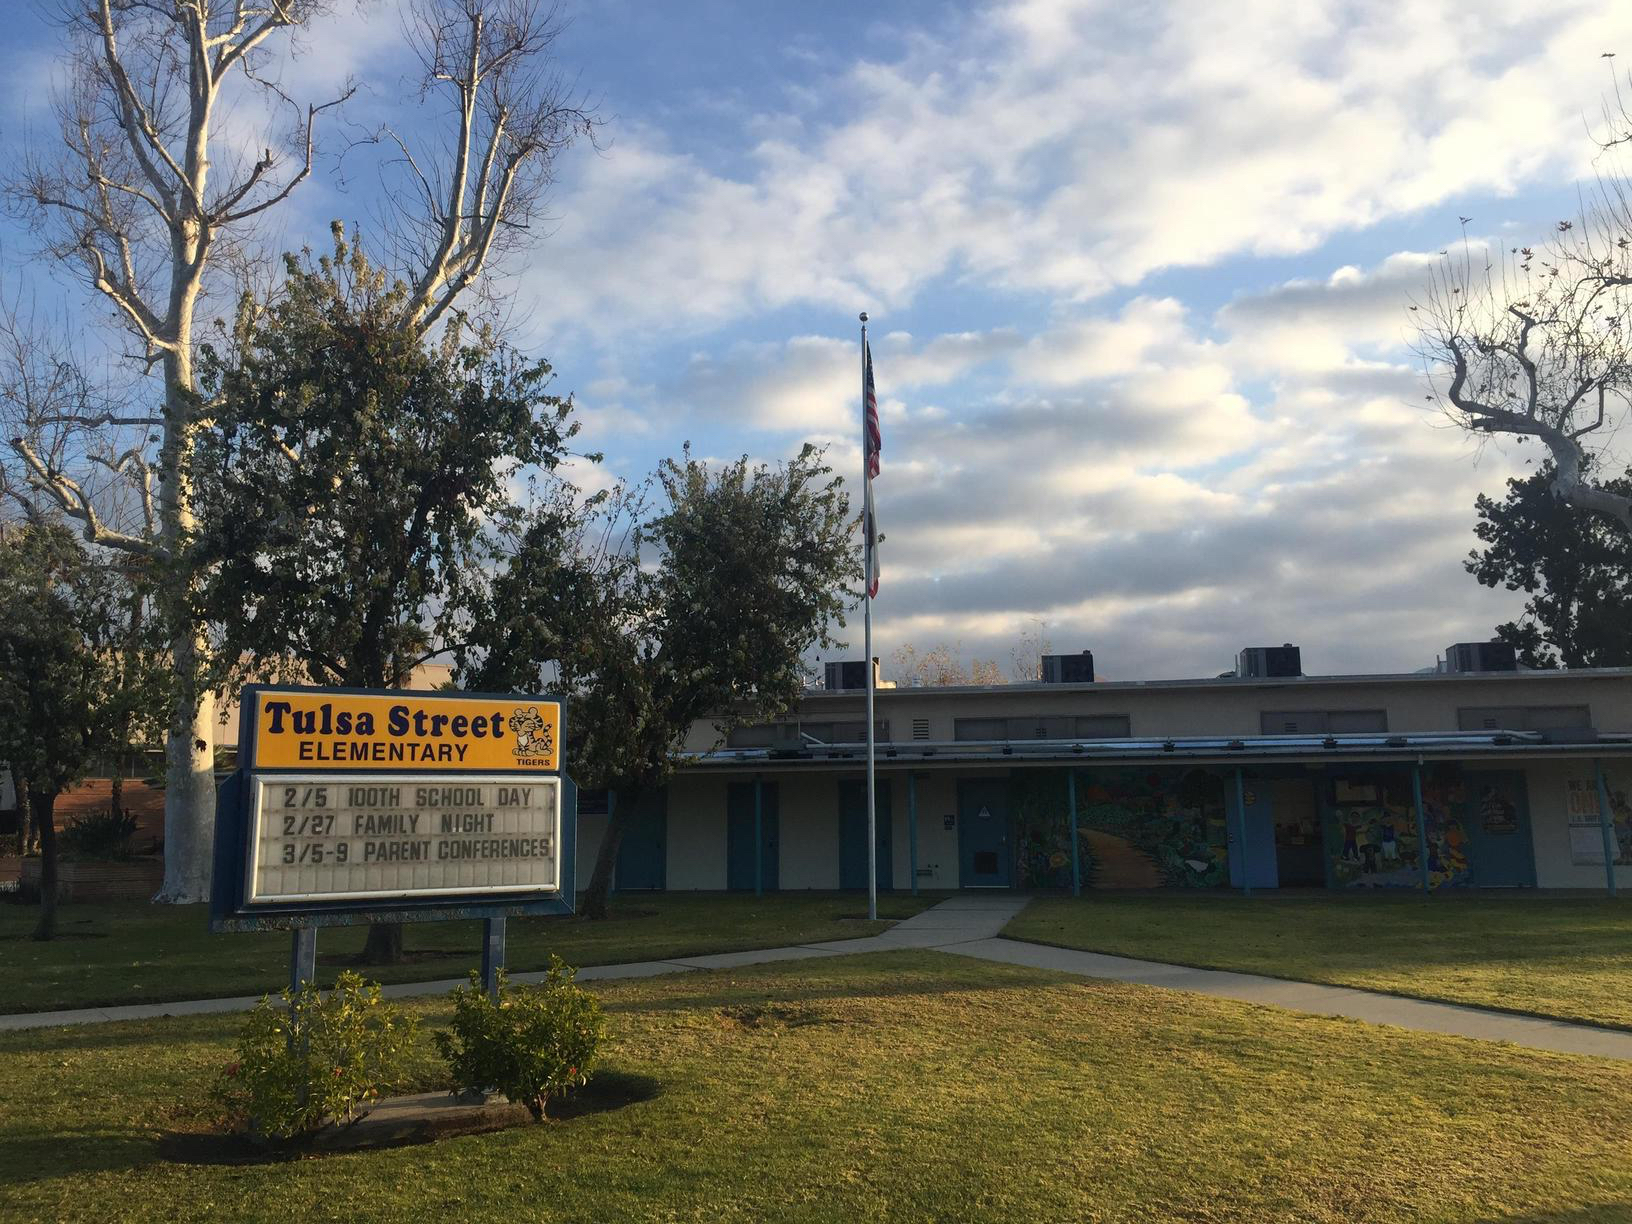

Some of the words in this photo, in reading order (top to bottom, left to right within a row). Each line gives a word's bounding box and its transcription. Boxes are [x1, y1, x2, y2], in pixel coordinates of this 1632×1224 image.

[265, 701, 375, 735] Tulsa
[388, 706, 505, 738] Street
[299, 742, 468, 761] ELEMENTARY
[285, 788, 327, 807] 2/5
[349, 788, 400, 807] 100TH
[416, 788, 484, 807] SCHOOL
[499, 788, 531, 806] DAY
[284, 815, 334, 835] 2/27
[355, 814, 418, 834] FAMILY
[441, 813, 494, 833] NIGHT
[283, 842, 348, 864] 3/5-9
[364, 840, 431, 861] PARENT
[438, 838, 549, 860] CONFERENCES
